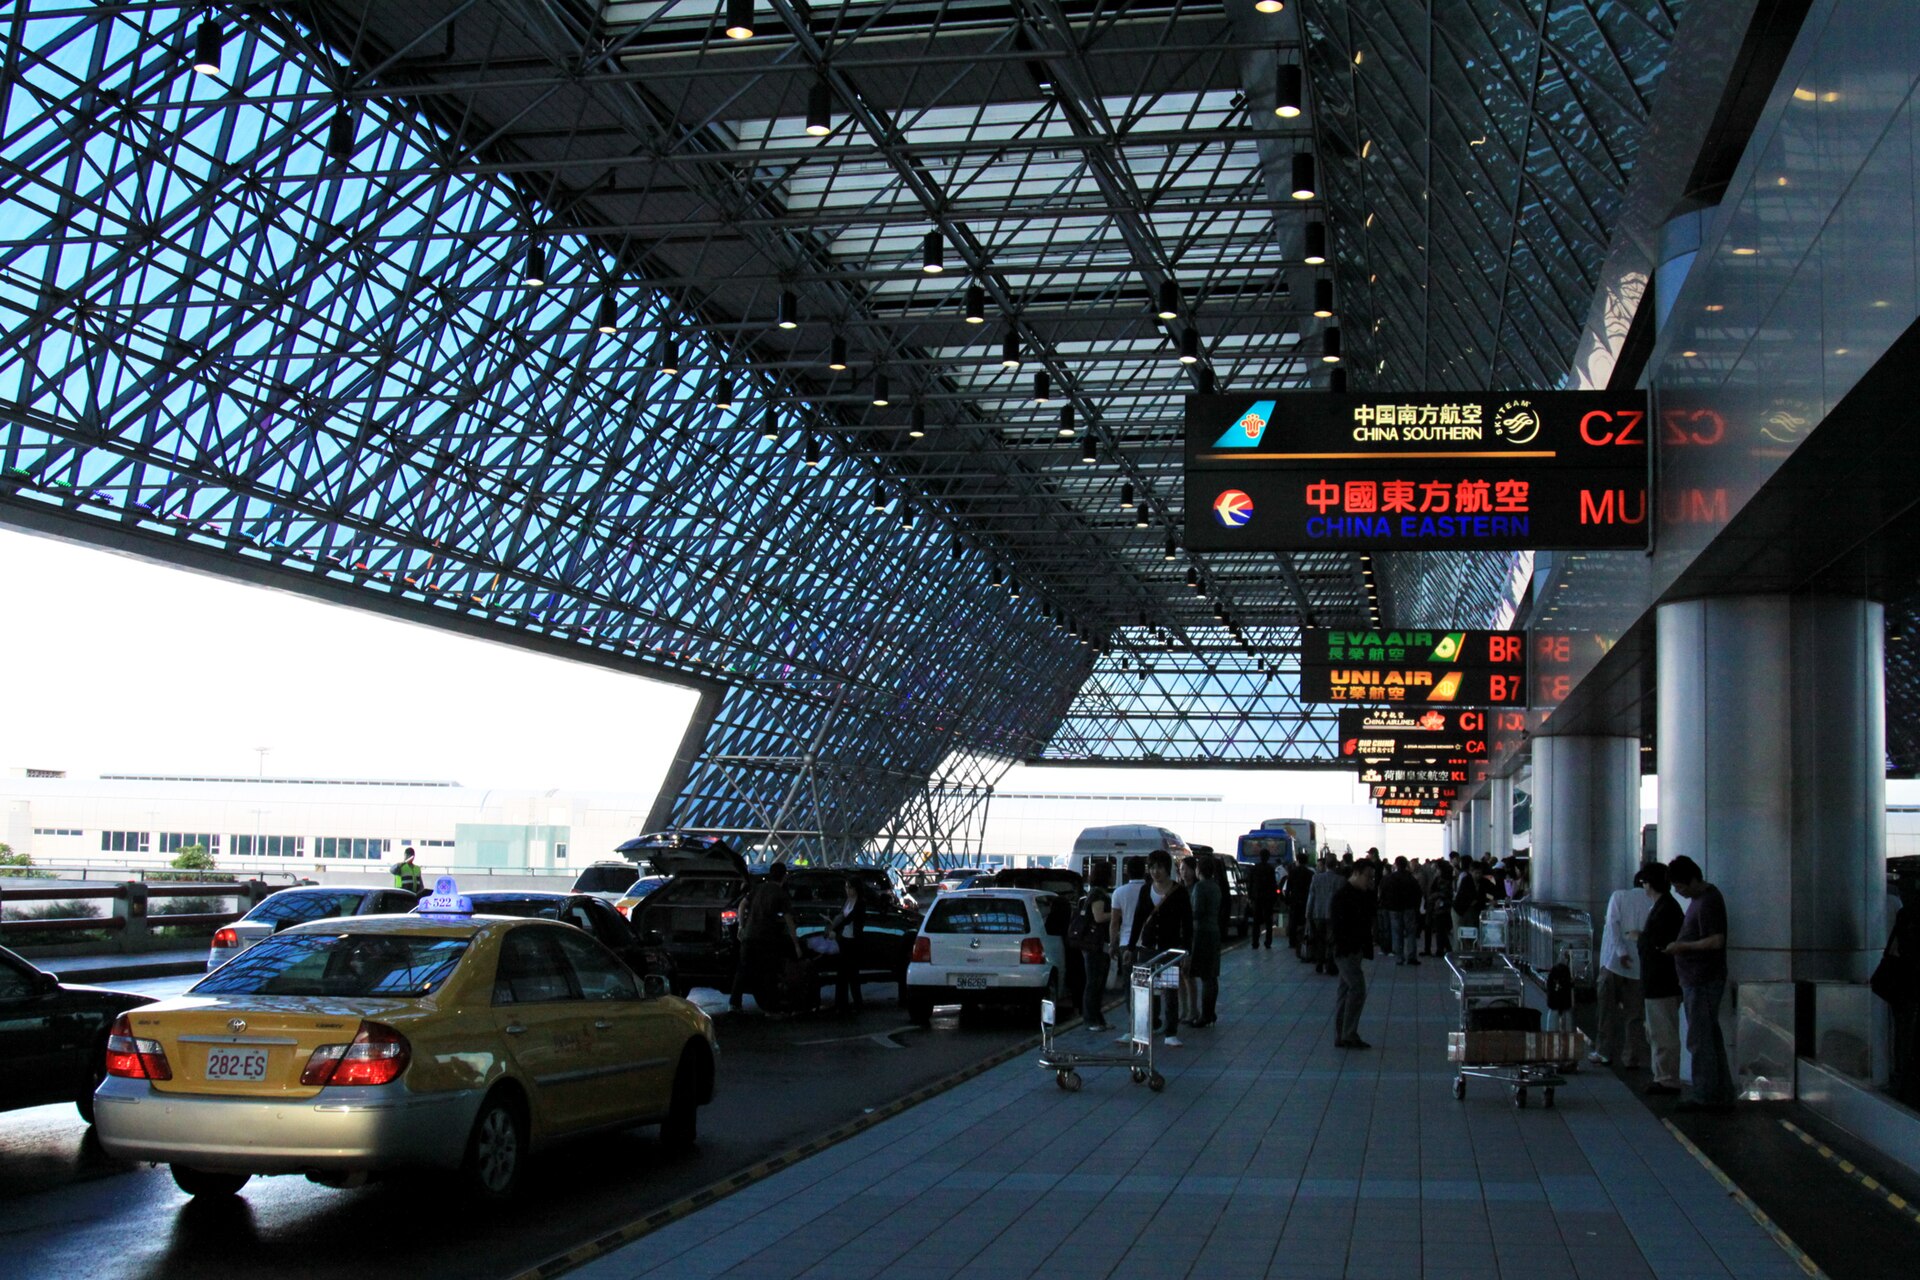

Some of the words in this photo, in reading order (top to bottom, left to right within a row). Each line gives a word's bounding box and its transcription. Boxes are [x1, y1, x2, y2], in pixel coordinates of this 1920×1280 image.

[1353, 404, 1483, 425] 中国南方航空
[1495, 400, 1532, 436] SKYTEAM
[1353, 424, 1399, 442] CHINA
[1403, 424, 1483, 442] SOUTHERN
[1579, 410, 1644, 446] CZ
[1306, 479, 1530, 514] 中國東方航空
[1580, 489, 1645, 525] MU
[1306, 516, 1391, 538] CHINA
[1400, 516, 1530, 538] EASTERN
[1489, 635, 1522, 662] BR
[1330, 670, 1380, 685] UNI
[1383, 670, 1433, 685] AIR
[1490, 674, 1521, 701] B7
[1330, 686, 1405, 701] 立榮航空
[1363, 718, 1385, 726] CHINA
[1386, 718, 1415, 726] AIRLINES
[1459, 712, 1484, 731] CI
[1358, 739, 1372, 747] AIR
[1372, 739, 1396, 747] CHINA
[1465, 740, 1486, 753] CA
[1451, 771, 1467, 781] KL
[433, 897, 452, 908] 522
[208, 1054, 266, 1077] 282-ES
